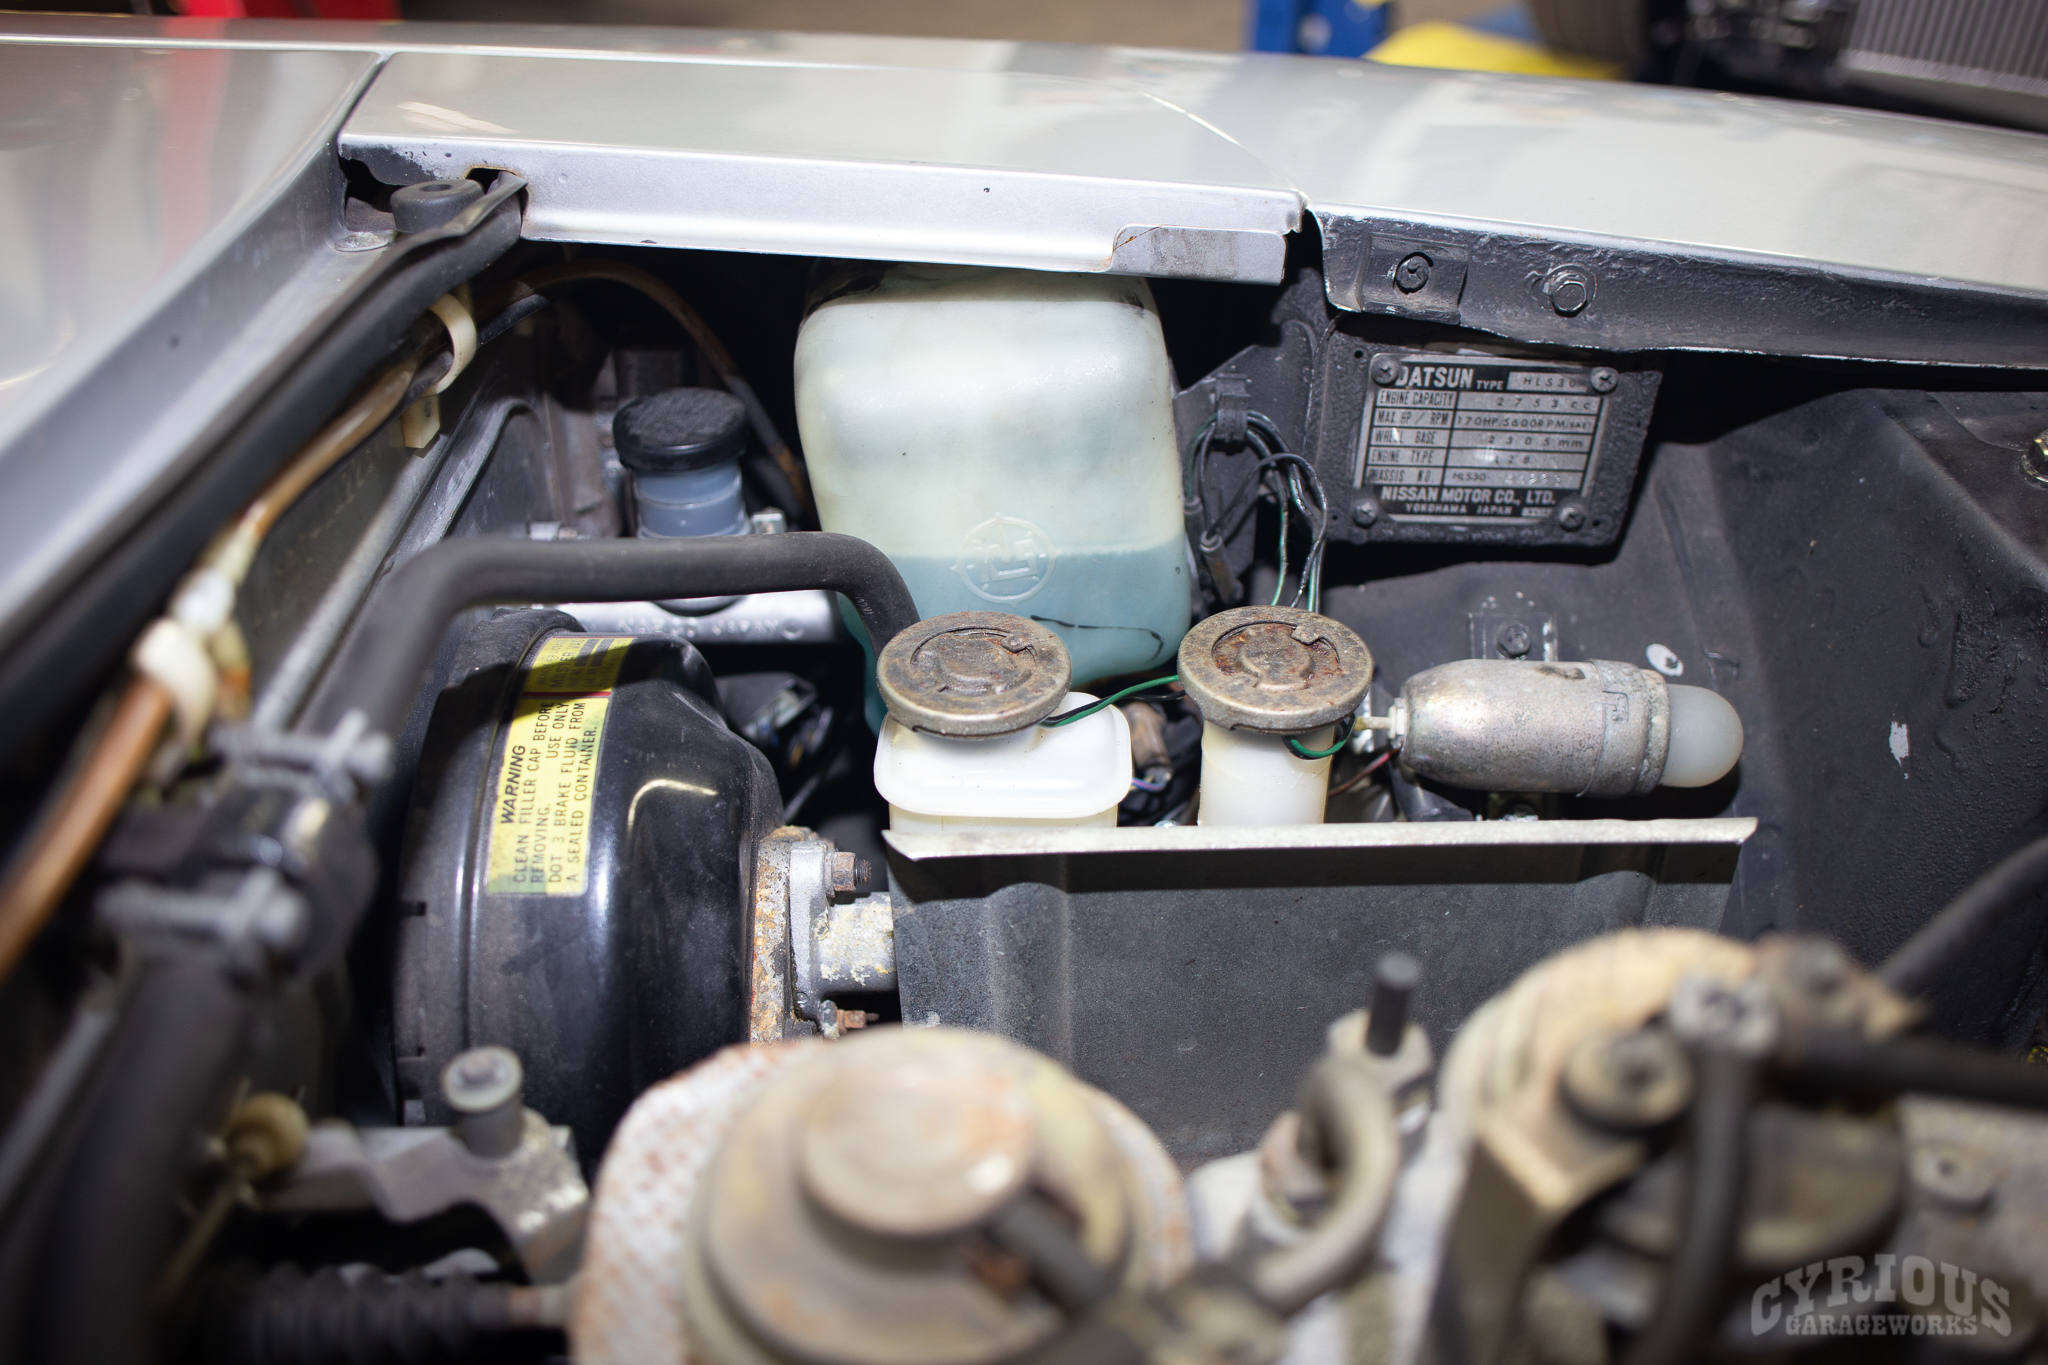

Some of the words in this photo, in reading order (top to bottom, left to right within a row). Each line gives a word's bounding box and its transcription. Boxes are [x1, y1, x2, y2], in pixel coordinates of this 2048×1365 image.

[1380, 389, 1411, 405] ENGINE
[1412, 391, 1455, 407] CAPACITY
[1476, 380, 1505, 391] TYPE
[1414, 431, 1437, 445] BASE
[1371, 449, 1400, 463] ENGINE
[1410, 450, 1435, 464] TYPE
[1380, 485, 1440, 501] NISSAN
[1441, 487, 1492, 504] MOTOR
[1405, 502, 1468, 515] YOKOHAMA
[1476, 504, 1513, 517] JAPAN
[532, 701, 555, 741] BEFORE
[551, 702, 570, 730] ONLY
[568, 702, 587, 730] FROM
[526, 747, 543, 773] CAP
[545, 735, 563, 759] USE
[560, 737, 579, 774] FLUID
[573, 726, 599, 802] CONTAINER.
[501, 745, 526, 825] WARNING
[519, 779, 538, 825] FILLER
[553, 781, 572, 827] BRAKE
[530, 803, 550, 884] REMOVING.
[552, 835, 566, 844] 3
[567, 809, 585, 864] SEALED
[513, 834, 530, 884] CLEAN
[548, 854, 563, 884] DOT
[566, 873, 580, 882] A
